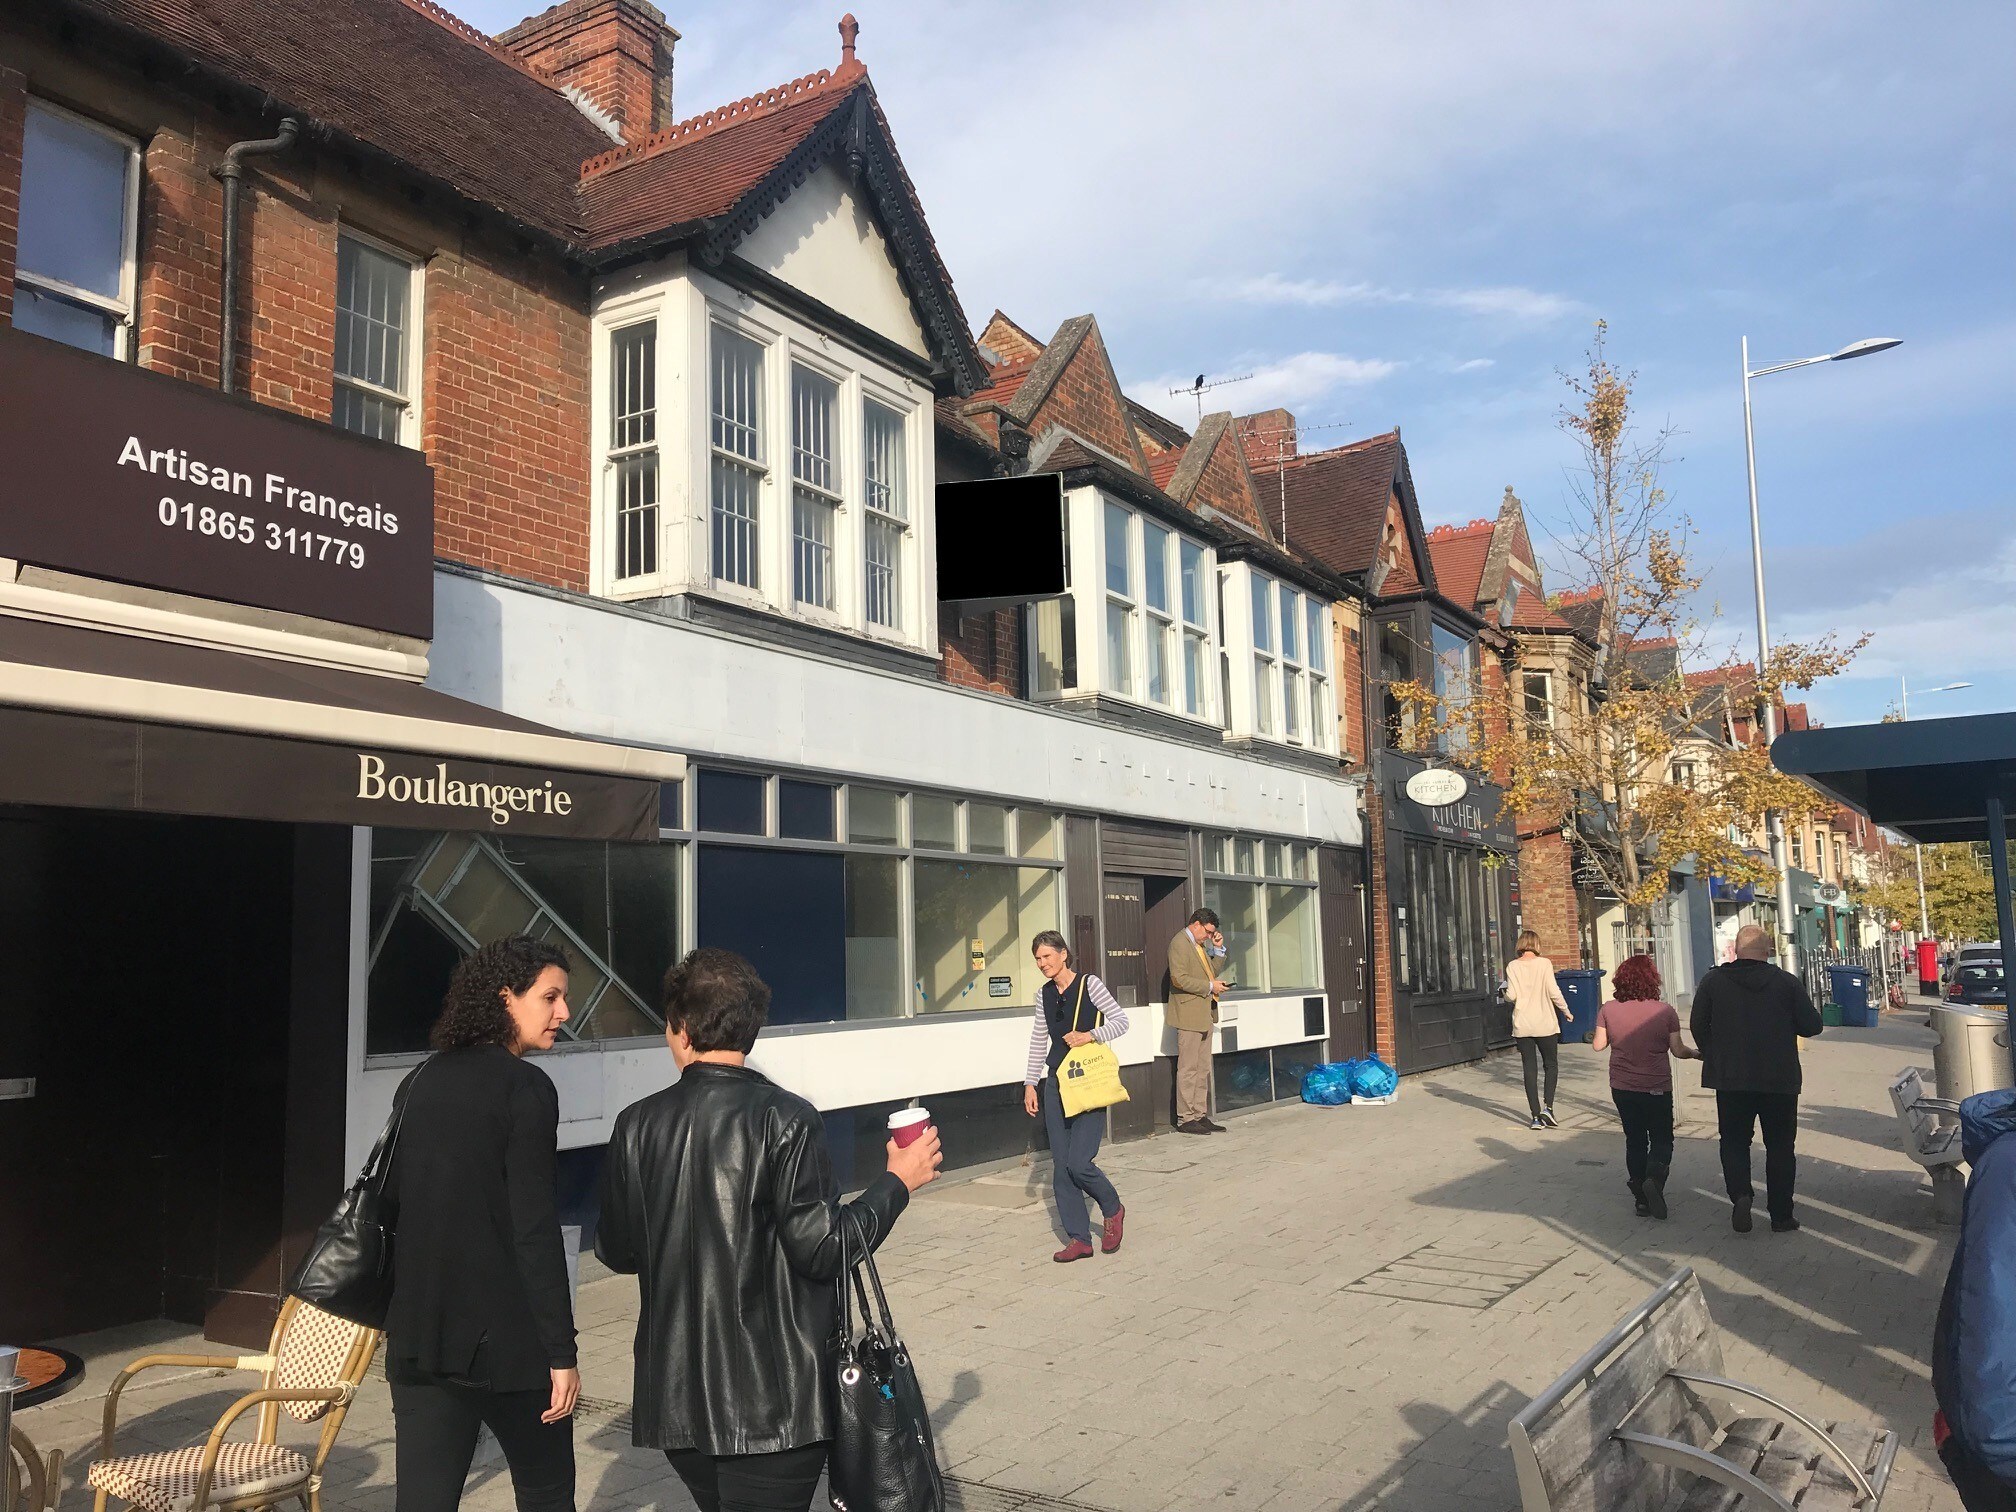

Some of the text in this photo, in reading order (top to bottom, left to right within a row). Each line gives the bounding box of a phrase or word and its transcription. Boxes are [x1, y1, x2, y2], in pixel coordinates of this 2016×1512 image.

[117, 436, 400, 536] Artisan Français
[158, 496, 366, 570] 01865 311779
[356, 753, 572, 825] Boulangerie
[1414, 784, 1457, 794] KITCHEN
[1082, 1054, 1104, 1066] Carers
